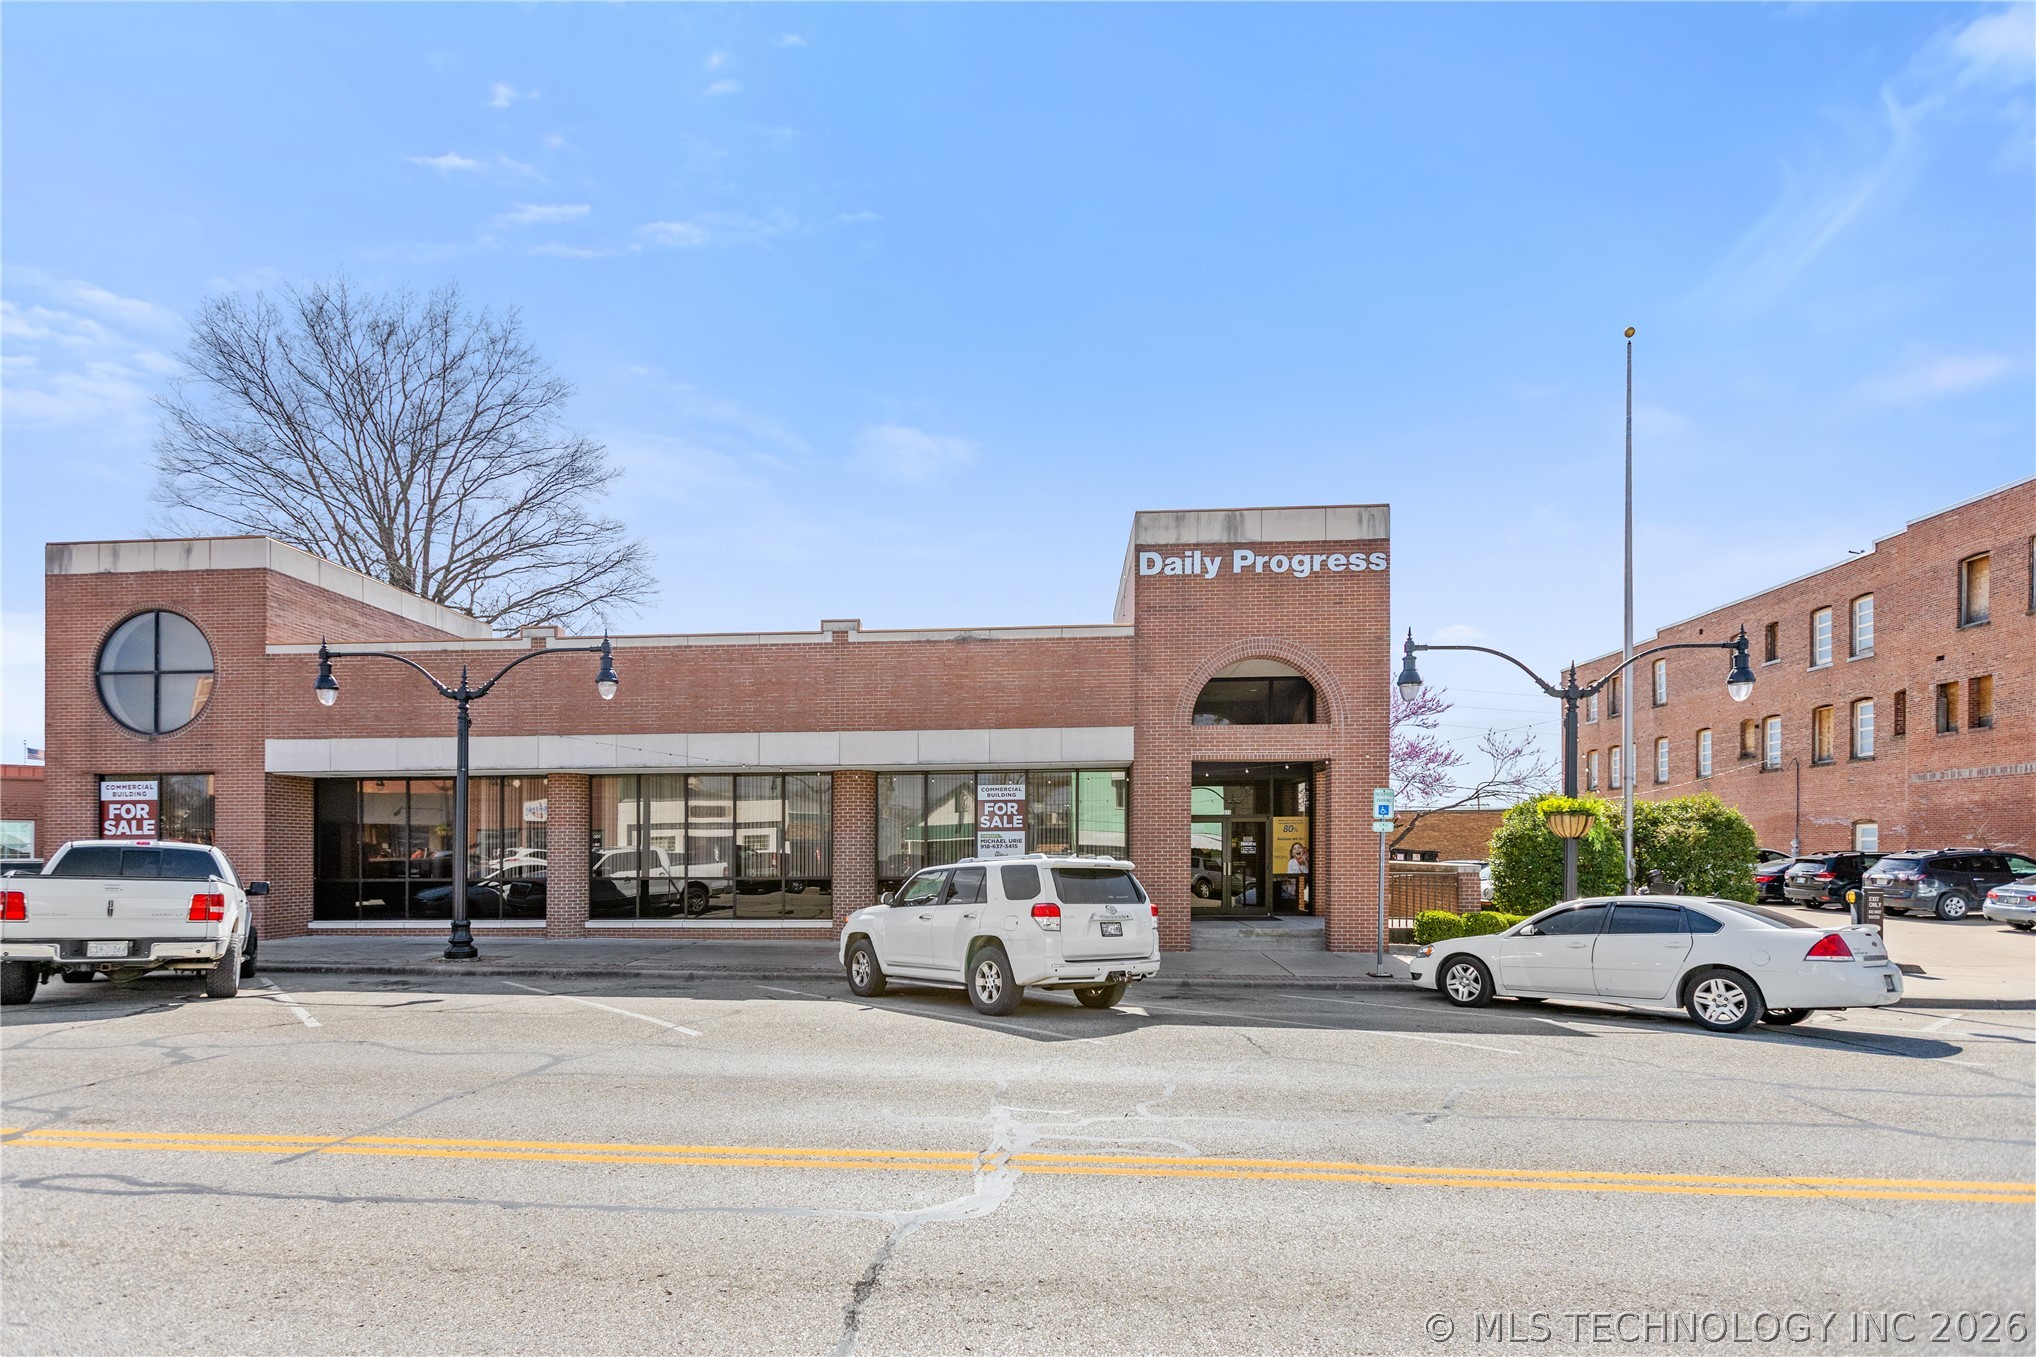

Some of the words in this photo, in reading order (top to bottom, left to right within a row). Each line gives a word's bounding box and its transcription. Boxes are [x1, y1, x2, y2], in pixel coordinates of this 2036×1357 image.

[1139, 550, 1222, 579] Daily
[1233, 549, 1388, 578] Progress
[109, 803, 149, 819] FOR
[984, 802, 1018, 815] FOR
[103, 820, 155, 836] SALE
[980, 815, 1023, 828] SALE
